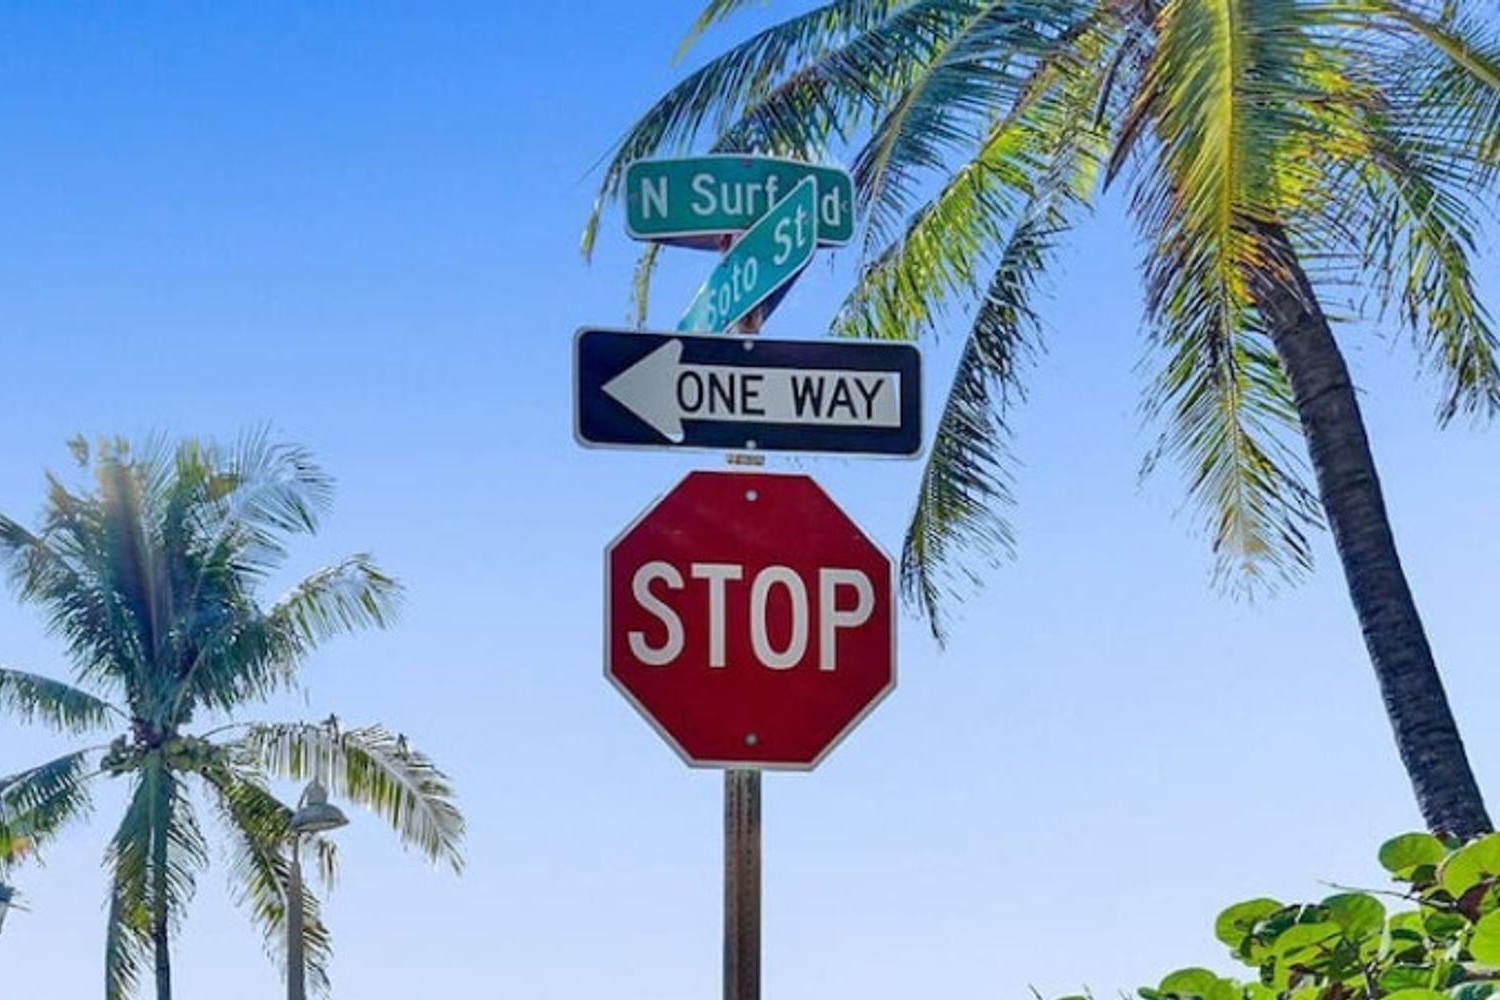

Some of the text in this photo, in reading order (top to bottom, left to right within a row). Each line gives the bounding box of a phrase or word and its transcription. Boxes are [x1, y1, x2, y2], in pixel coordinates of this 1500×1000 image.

[641, 173, 841, 227] N Surf d
[773, 204, 807, 266] St
[675, 370, 885, 419] ONE WAY
[626, 560, 876, 672] STOP
